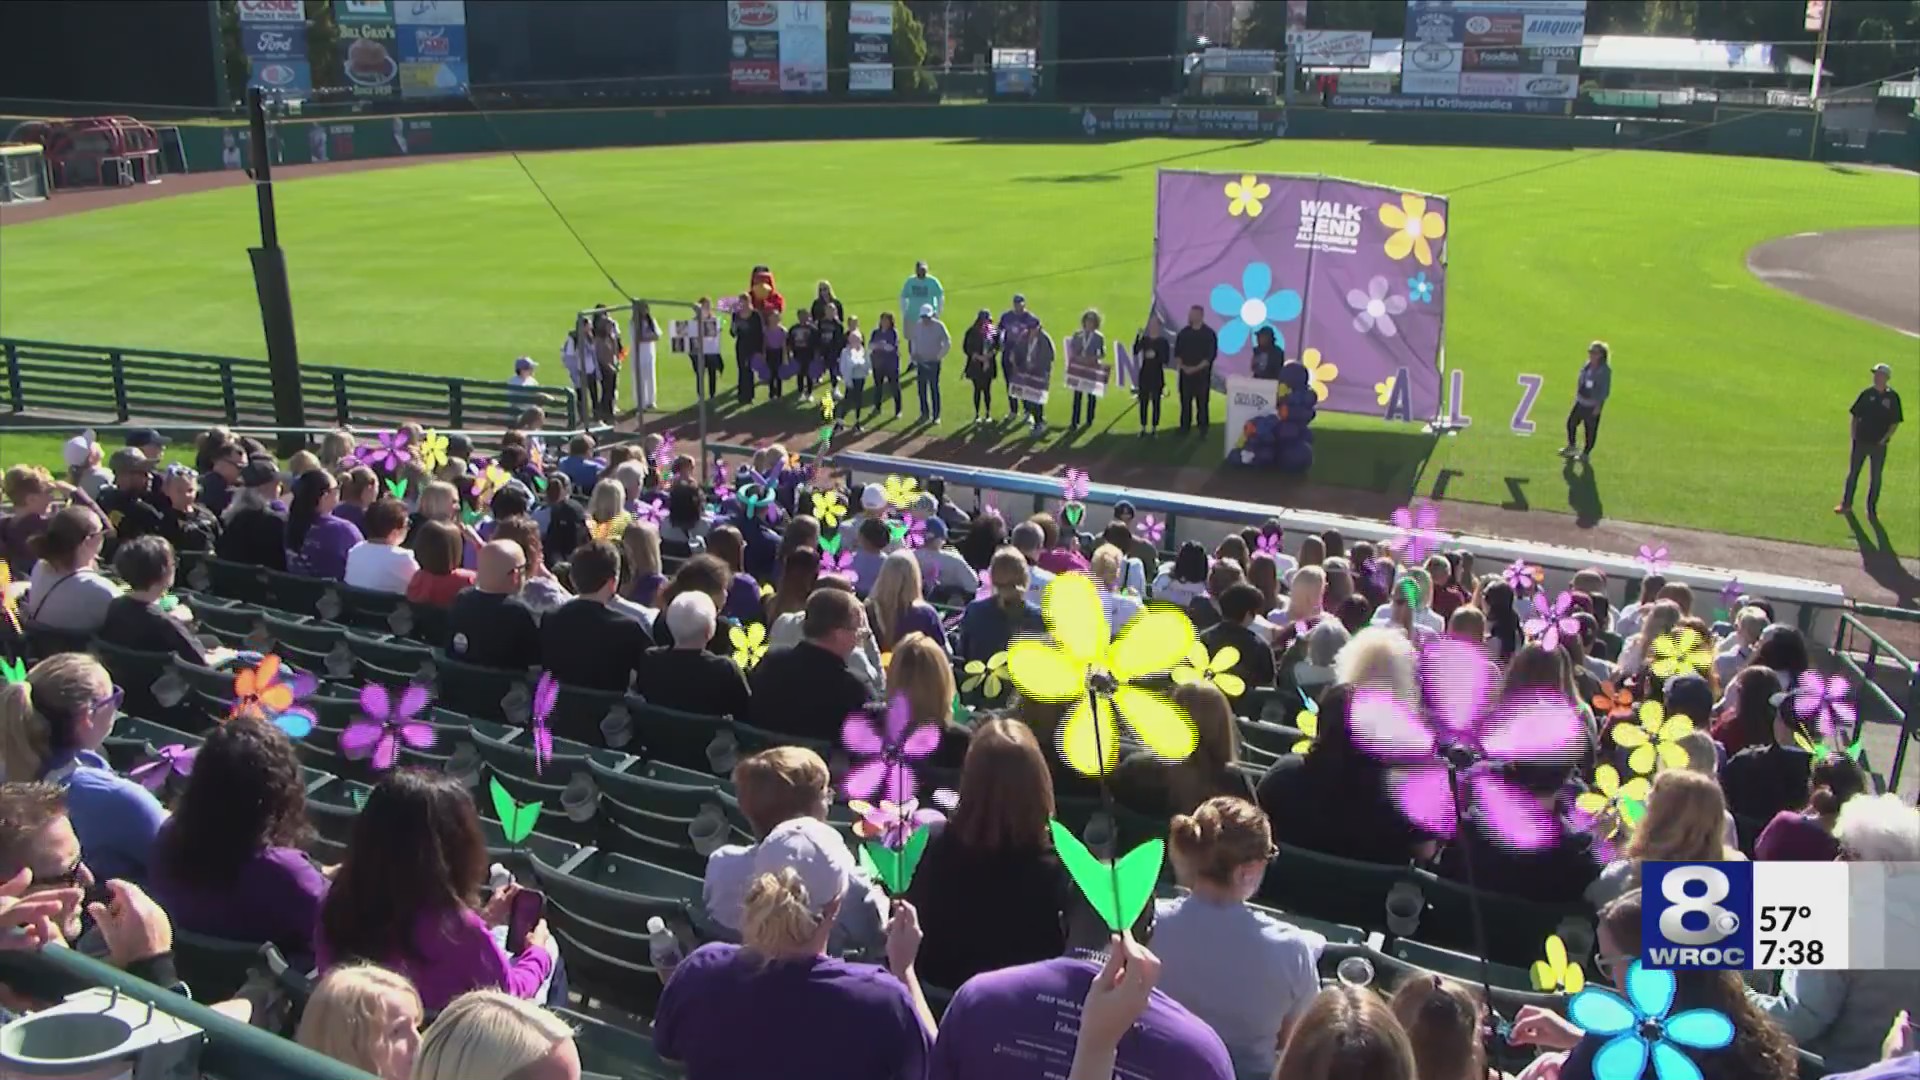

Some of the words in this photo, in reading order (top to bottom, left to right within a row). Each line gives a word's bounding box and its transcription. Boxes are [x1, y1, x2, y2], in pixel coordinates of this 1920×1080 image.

[1527, 19, 1583, 36] AIRQUIP
[257, 31, 292, 51] Ford
[1333, 95, 1365, 106] Game
[1367, 95, 1421, 109] Changers
[1423, 96, 1434, 107] in
[1436, 97, 1513, 112] Orthopaedics
[1300, 199, 1362, 221] WALK
[1315, 217, 1360, 237] END
[1384, 366, 1412, 421] A
[1449, 368, 1472, 428] L
[1510, 373, 1544, 433] Z
